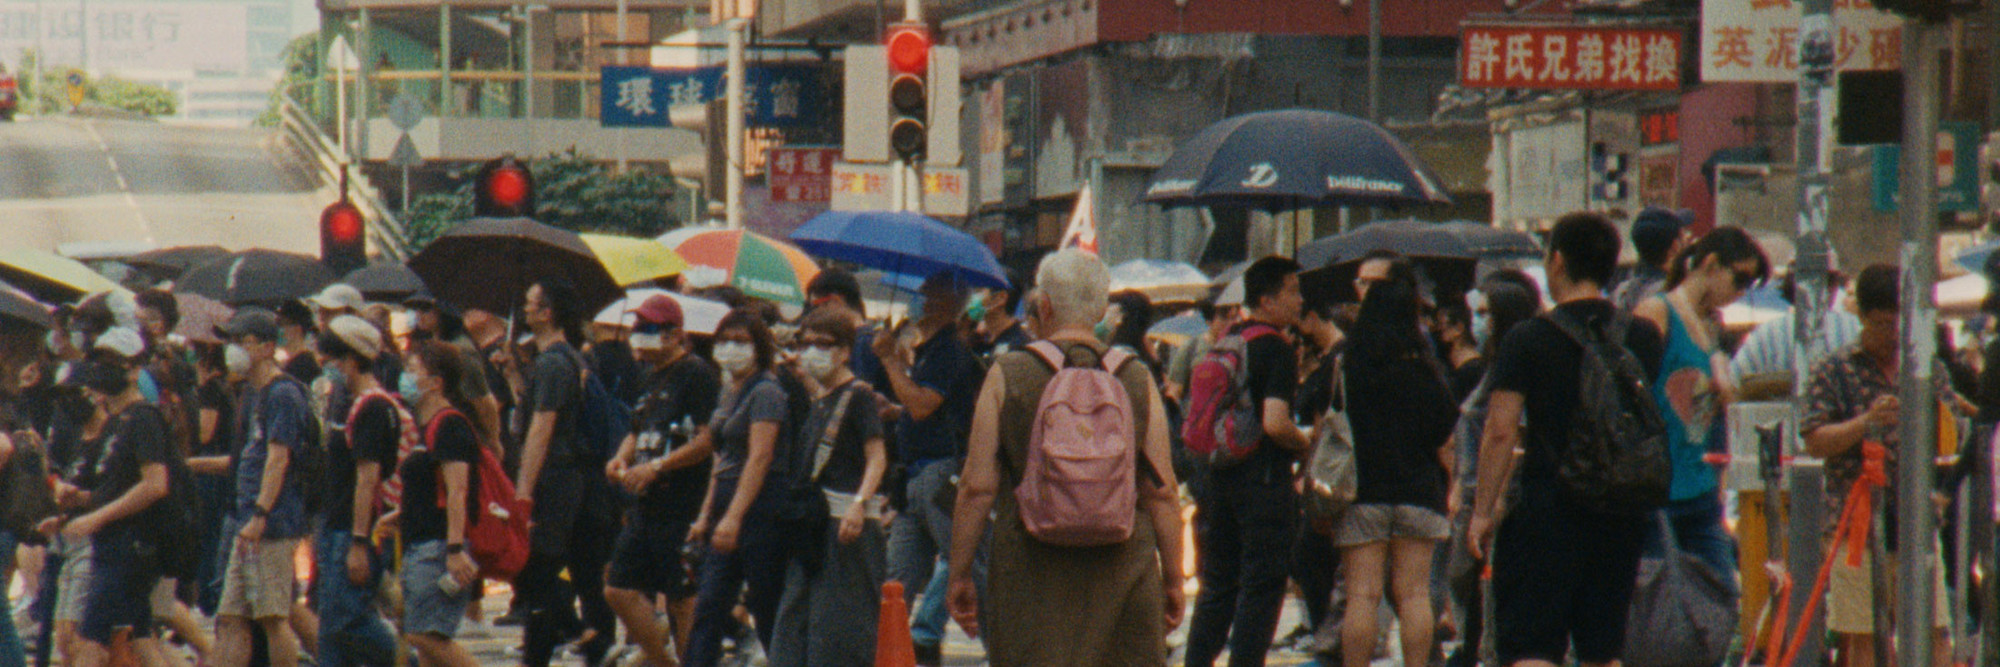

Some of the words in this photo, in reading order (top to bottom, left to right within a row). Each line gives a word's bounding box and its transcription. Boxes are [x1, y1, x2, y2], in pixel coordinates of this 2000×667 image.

[1467, 33, 1678, 83] 許氏兄弟找換
